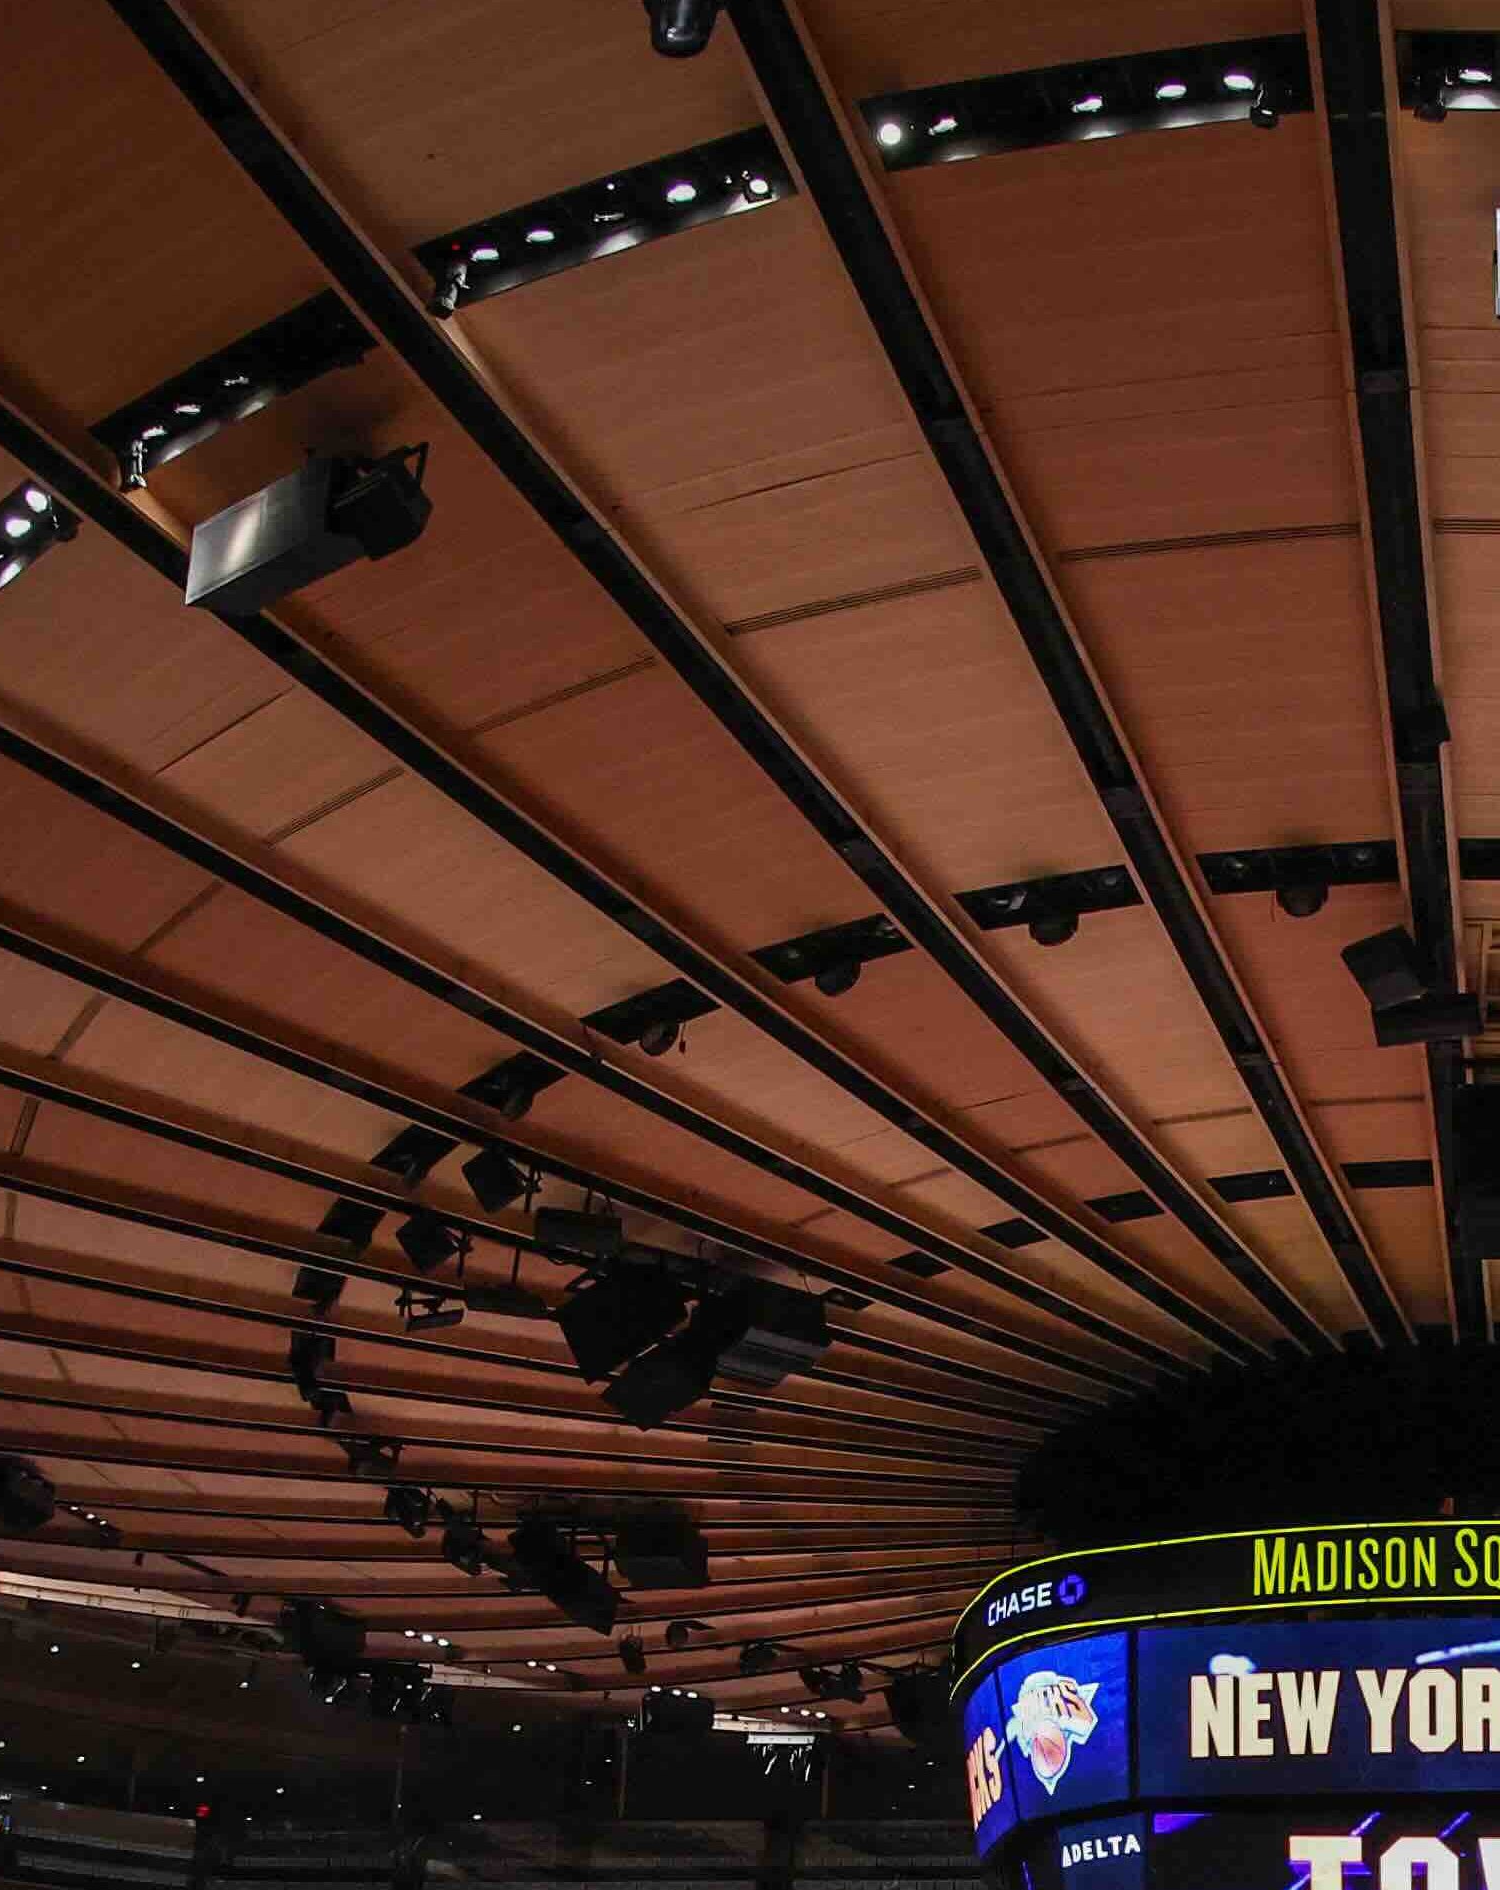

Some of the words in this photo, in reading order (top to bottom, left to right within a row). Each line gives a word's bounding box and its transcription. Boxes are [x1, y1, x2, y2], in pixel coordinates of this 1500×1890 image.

[1253, 1536, 1438, 1597] MADISON
[987, 1581, 1053, 1627] CHASE
[1189, 1669, 1342, 1758] NEW
[1071, 1833, 1142, 1863] DELTA
